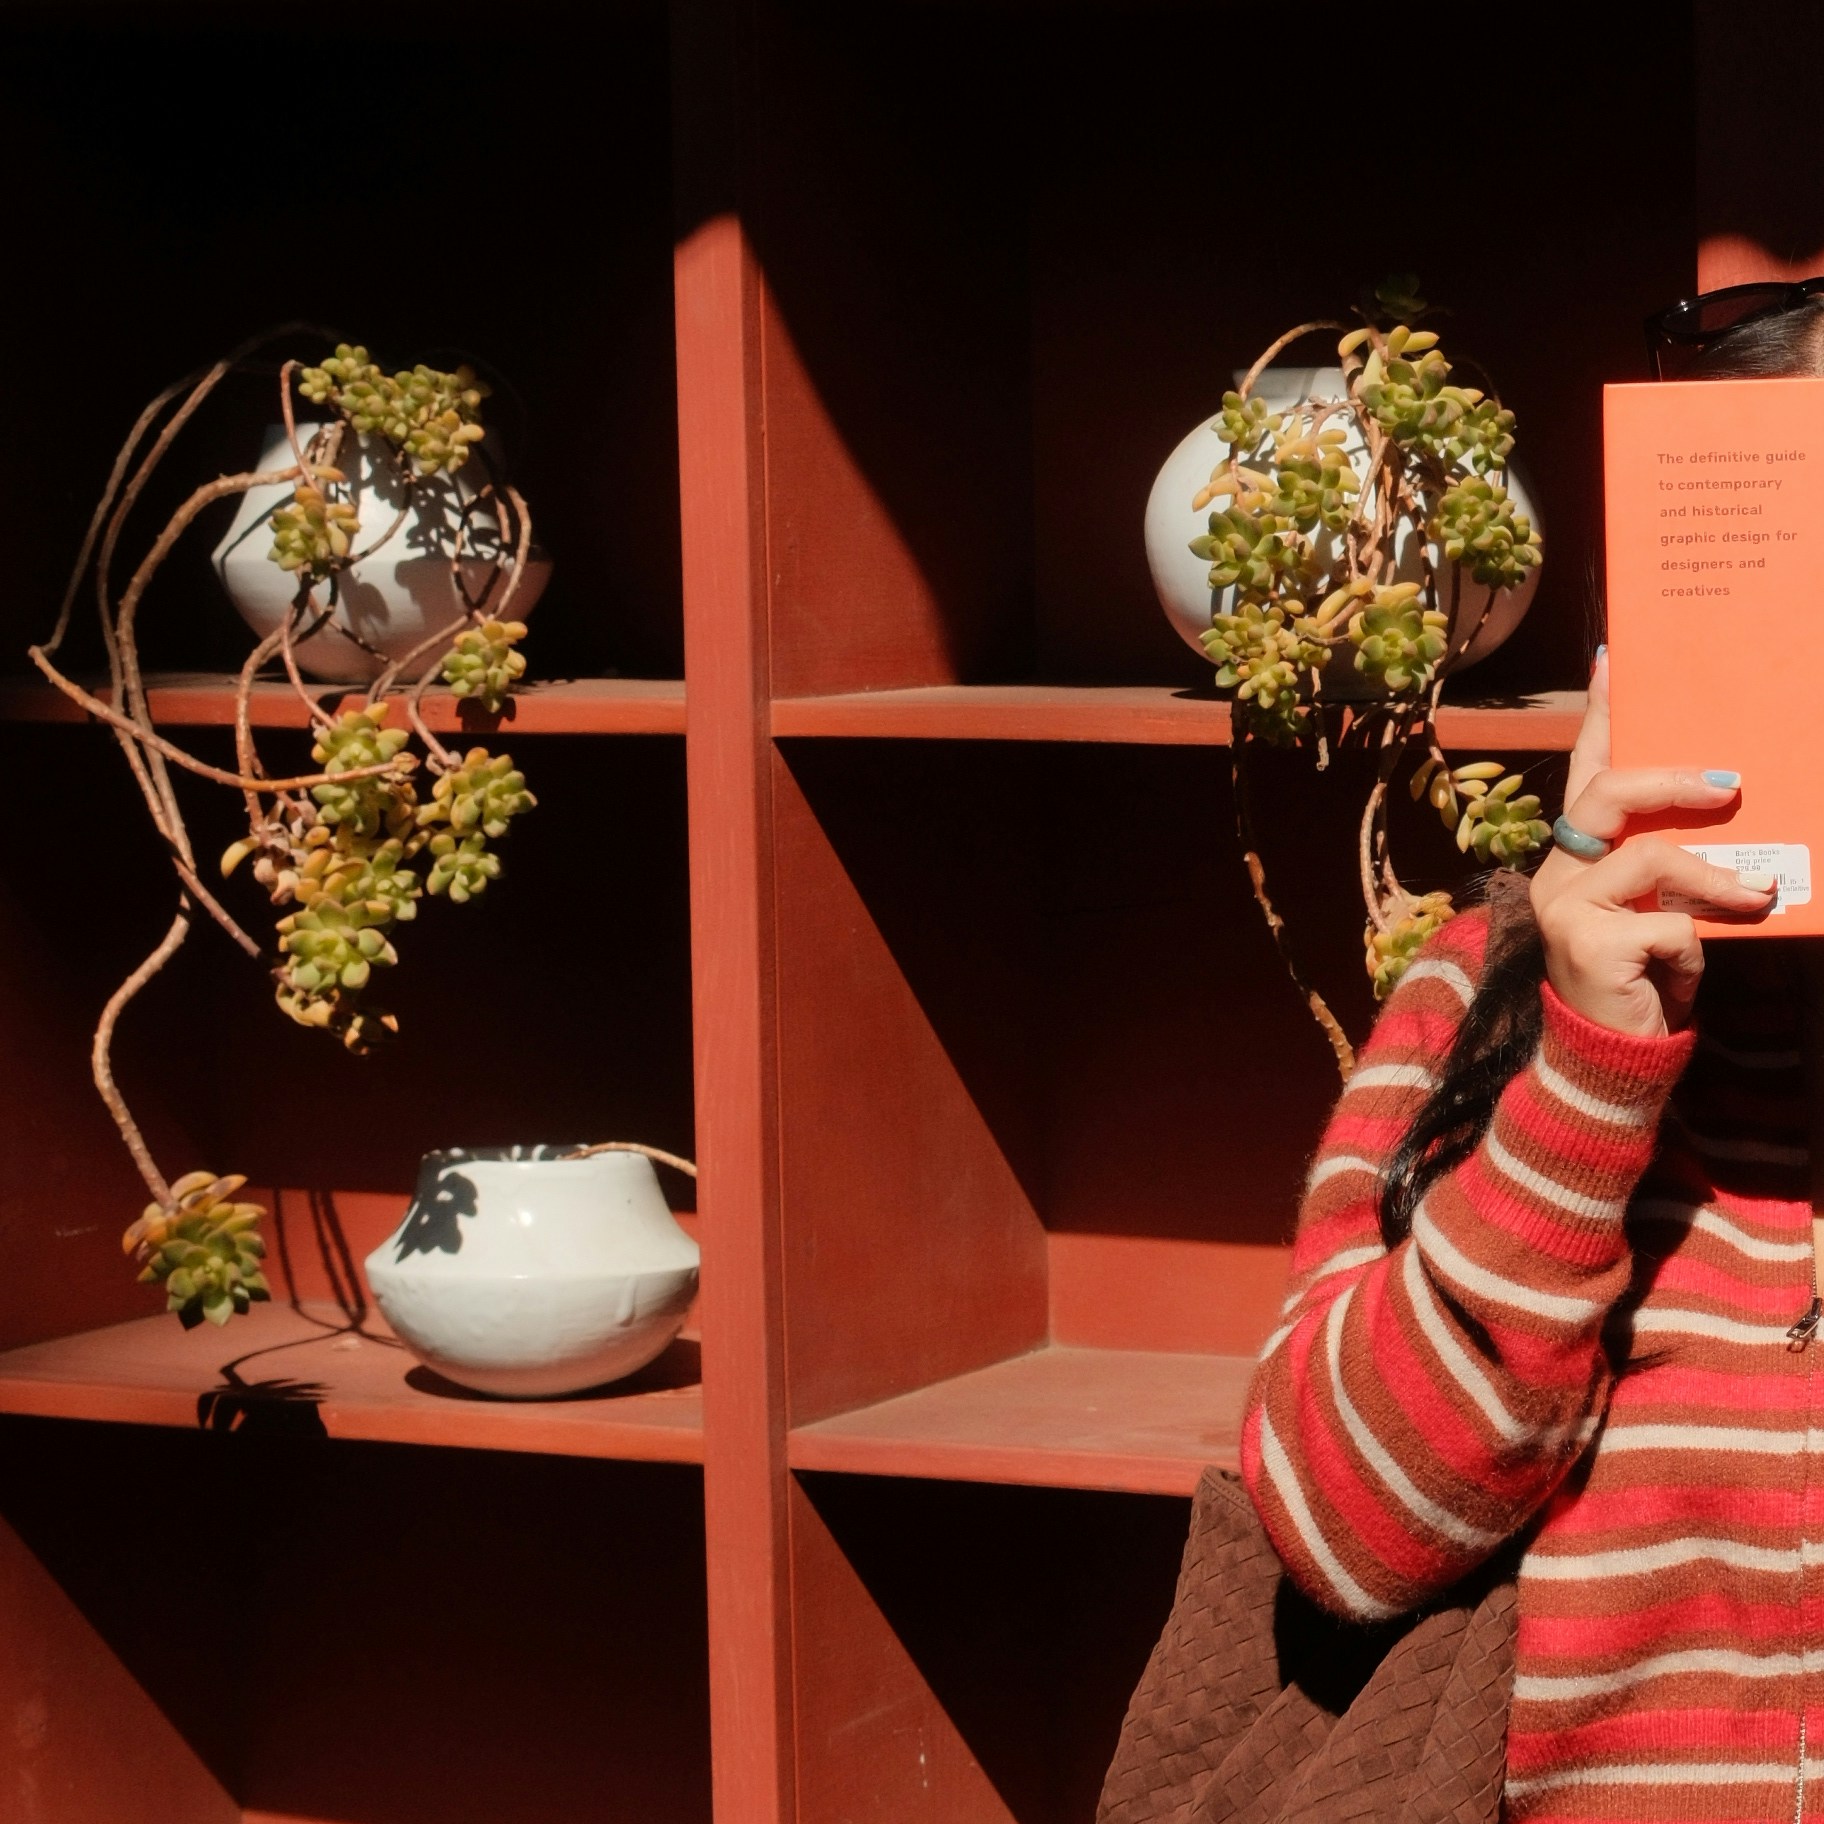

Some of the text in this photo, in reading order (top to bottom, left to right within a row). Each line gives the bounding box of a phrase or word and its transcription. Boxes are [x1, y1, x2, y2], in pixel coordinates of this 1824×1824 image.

[1657, 450, 1806, 464] The definitive guide
[1659, 479, 1782, 491] to contemporary
[1660, 505, 1762, 518] and historical
[1660, 530, 1797, 546] graphic design for
[1661, 558, 1765, 572] designers and
[1661, 585, 1730, 597] creatives
[1753, 857, 1772, 866] price
